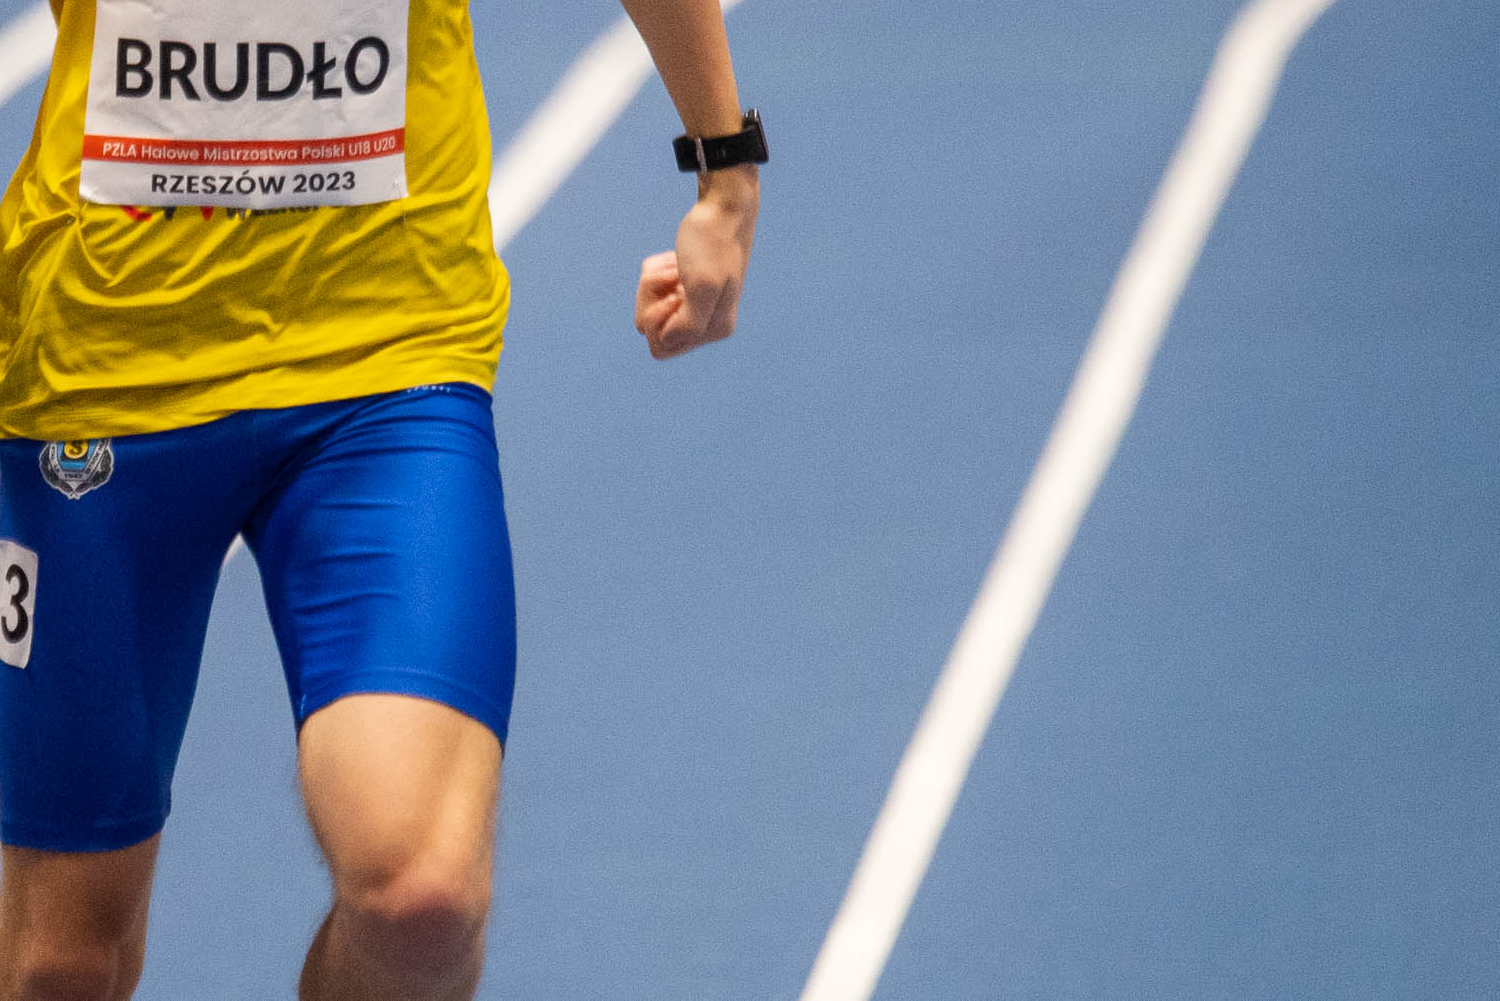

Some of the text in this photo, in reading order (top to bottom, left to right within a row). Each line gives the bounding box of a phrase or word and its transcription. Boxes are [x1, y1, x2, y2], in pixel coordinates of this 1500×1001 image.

[115, 36, 390, 103] BRUDŁO
[102, 136, 396, 162] PZLA Halowe Mistrzostwa Polski U18 U20
[151, 169, 356, 195] RZESZÓW 2023
[1, 563, 31, 644] 3
